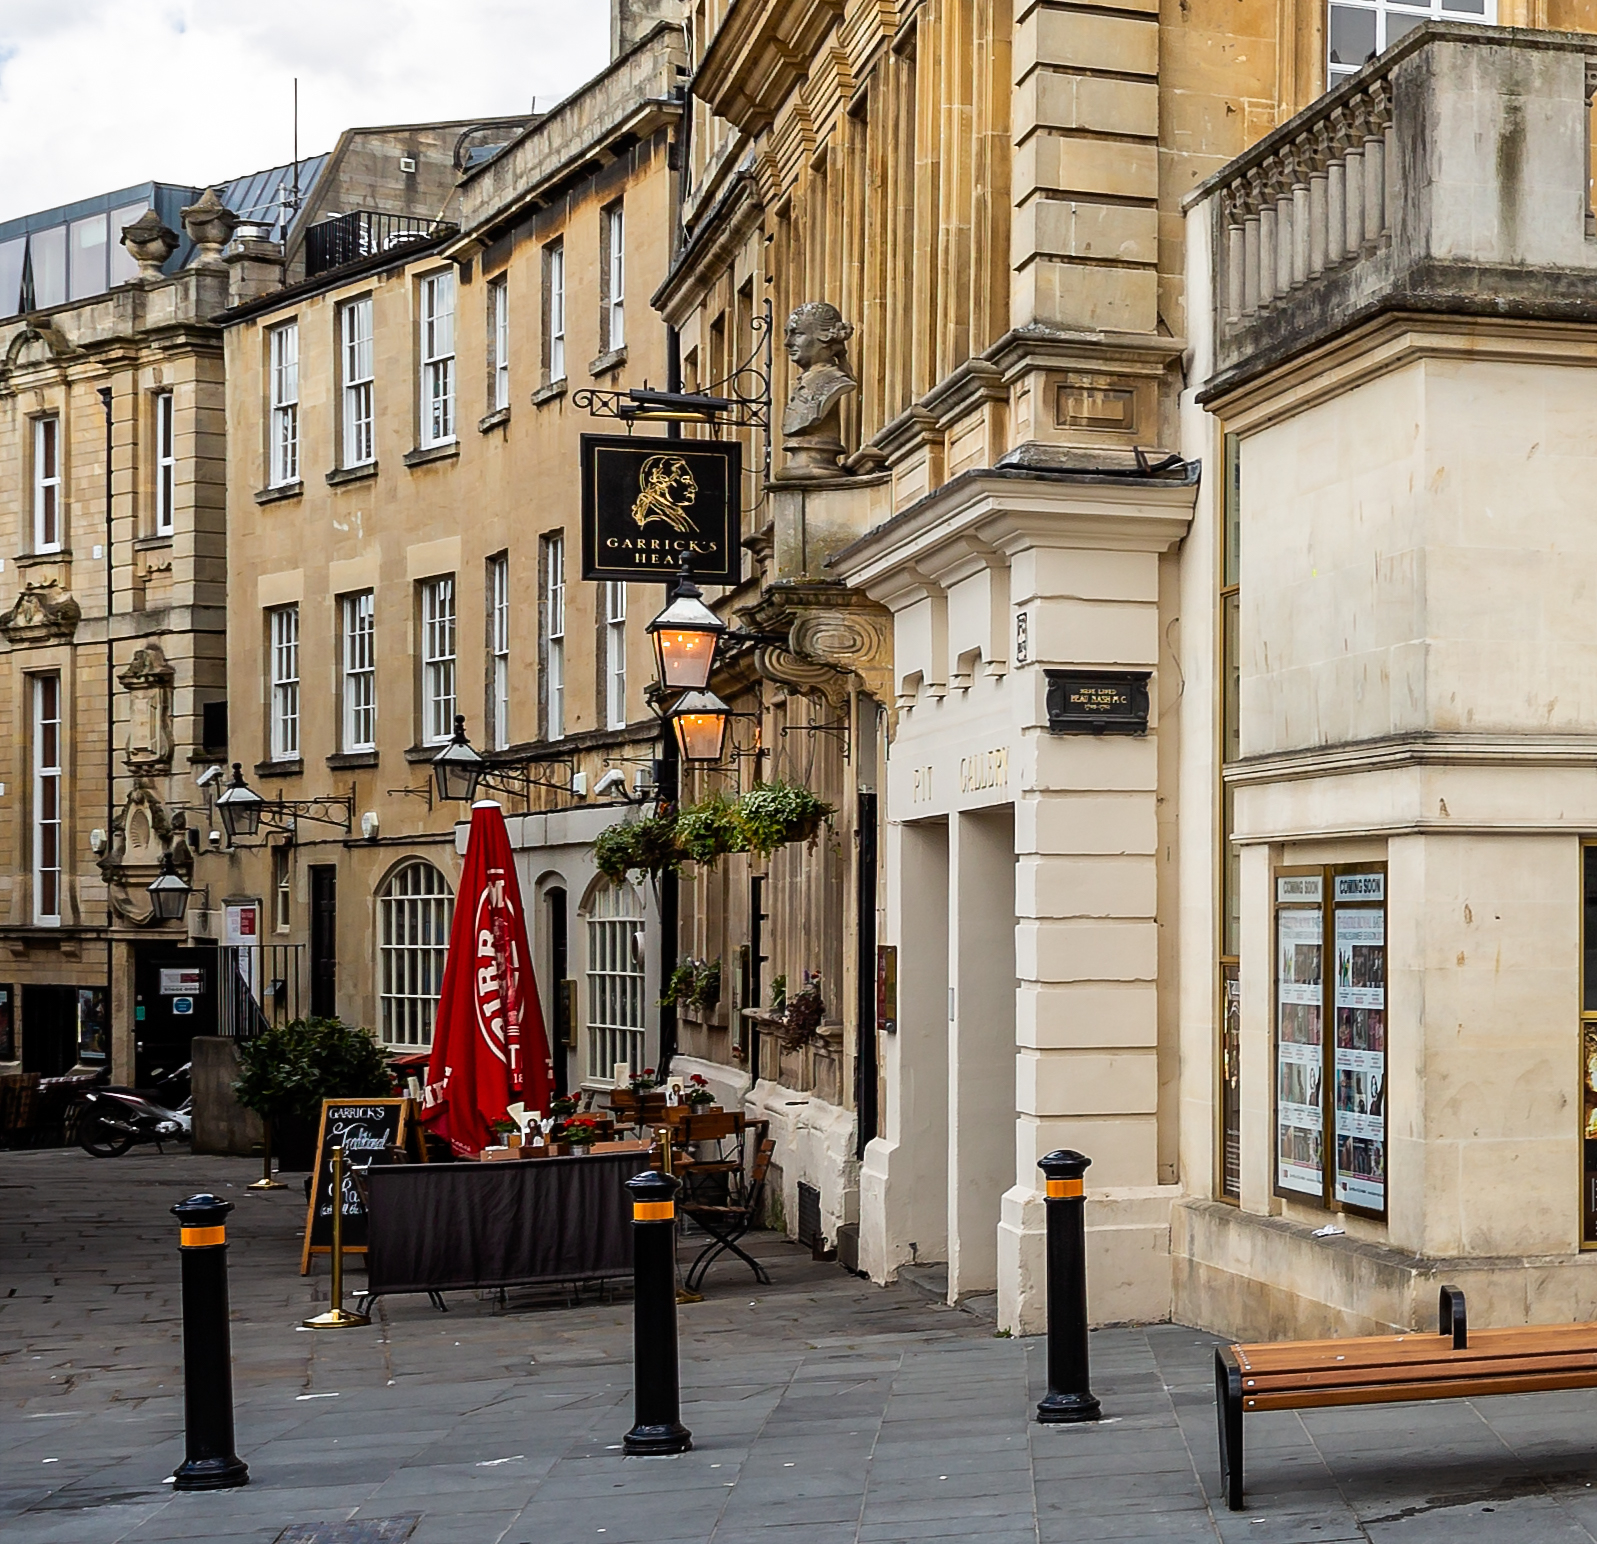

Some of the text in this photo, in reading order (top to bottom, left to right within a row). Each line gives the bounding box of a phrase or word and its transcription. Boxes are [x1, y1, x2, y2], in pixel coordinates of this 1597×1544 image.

[607, 538, 717, 553] GARRICK'S
[913, 746, 1009, 803] PIT GALLERY
[1284, 880, 1319, 894] COMING SOON
[1340, 879, 1380, 894] COMING SOON
[329, 1107, 385, 1120] GARRICK'S
